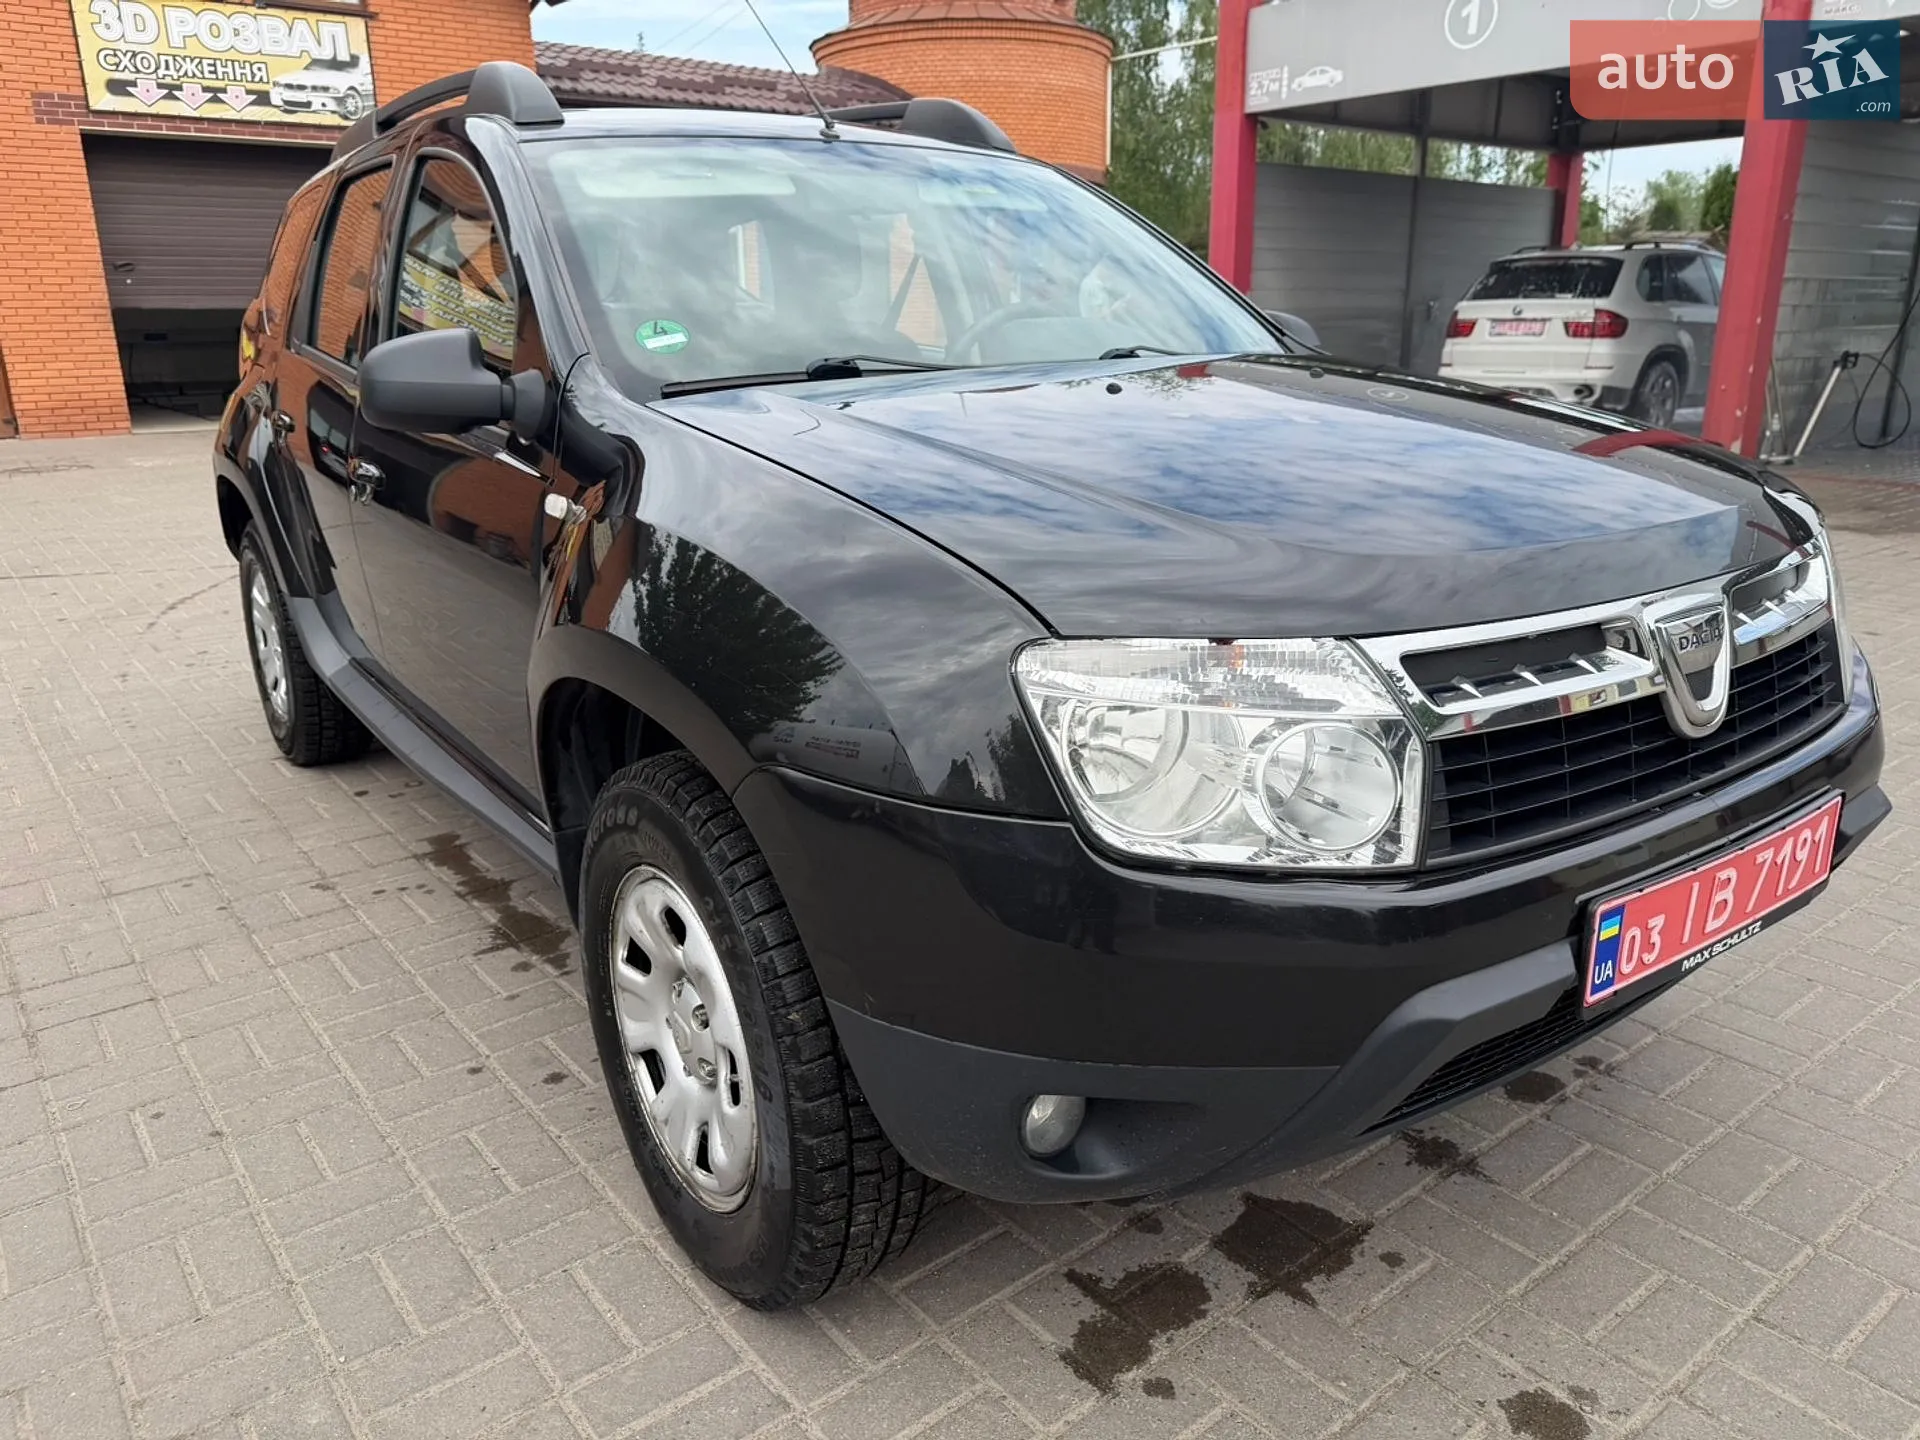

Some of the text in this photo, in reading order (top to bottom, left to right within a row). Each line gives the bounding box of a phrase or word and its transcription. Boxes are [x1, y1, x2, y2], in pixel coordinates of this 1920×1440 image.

[90, 0, 351, 61] 3D РОЗВАЛ
[1461, 0, 1480, 35] 1
[98, 48, 270, 83] СХОДЖЕННЯ
[1679, 627, 1722, 651] DACIA
[1618, 913, 1666, 975] 03
[1745, 815, 1830, 913] 7191
[1681, 920, 1762, 972] MAX SCHULTZ
[1594, 959, 1613, 985] UA
